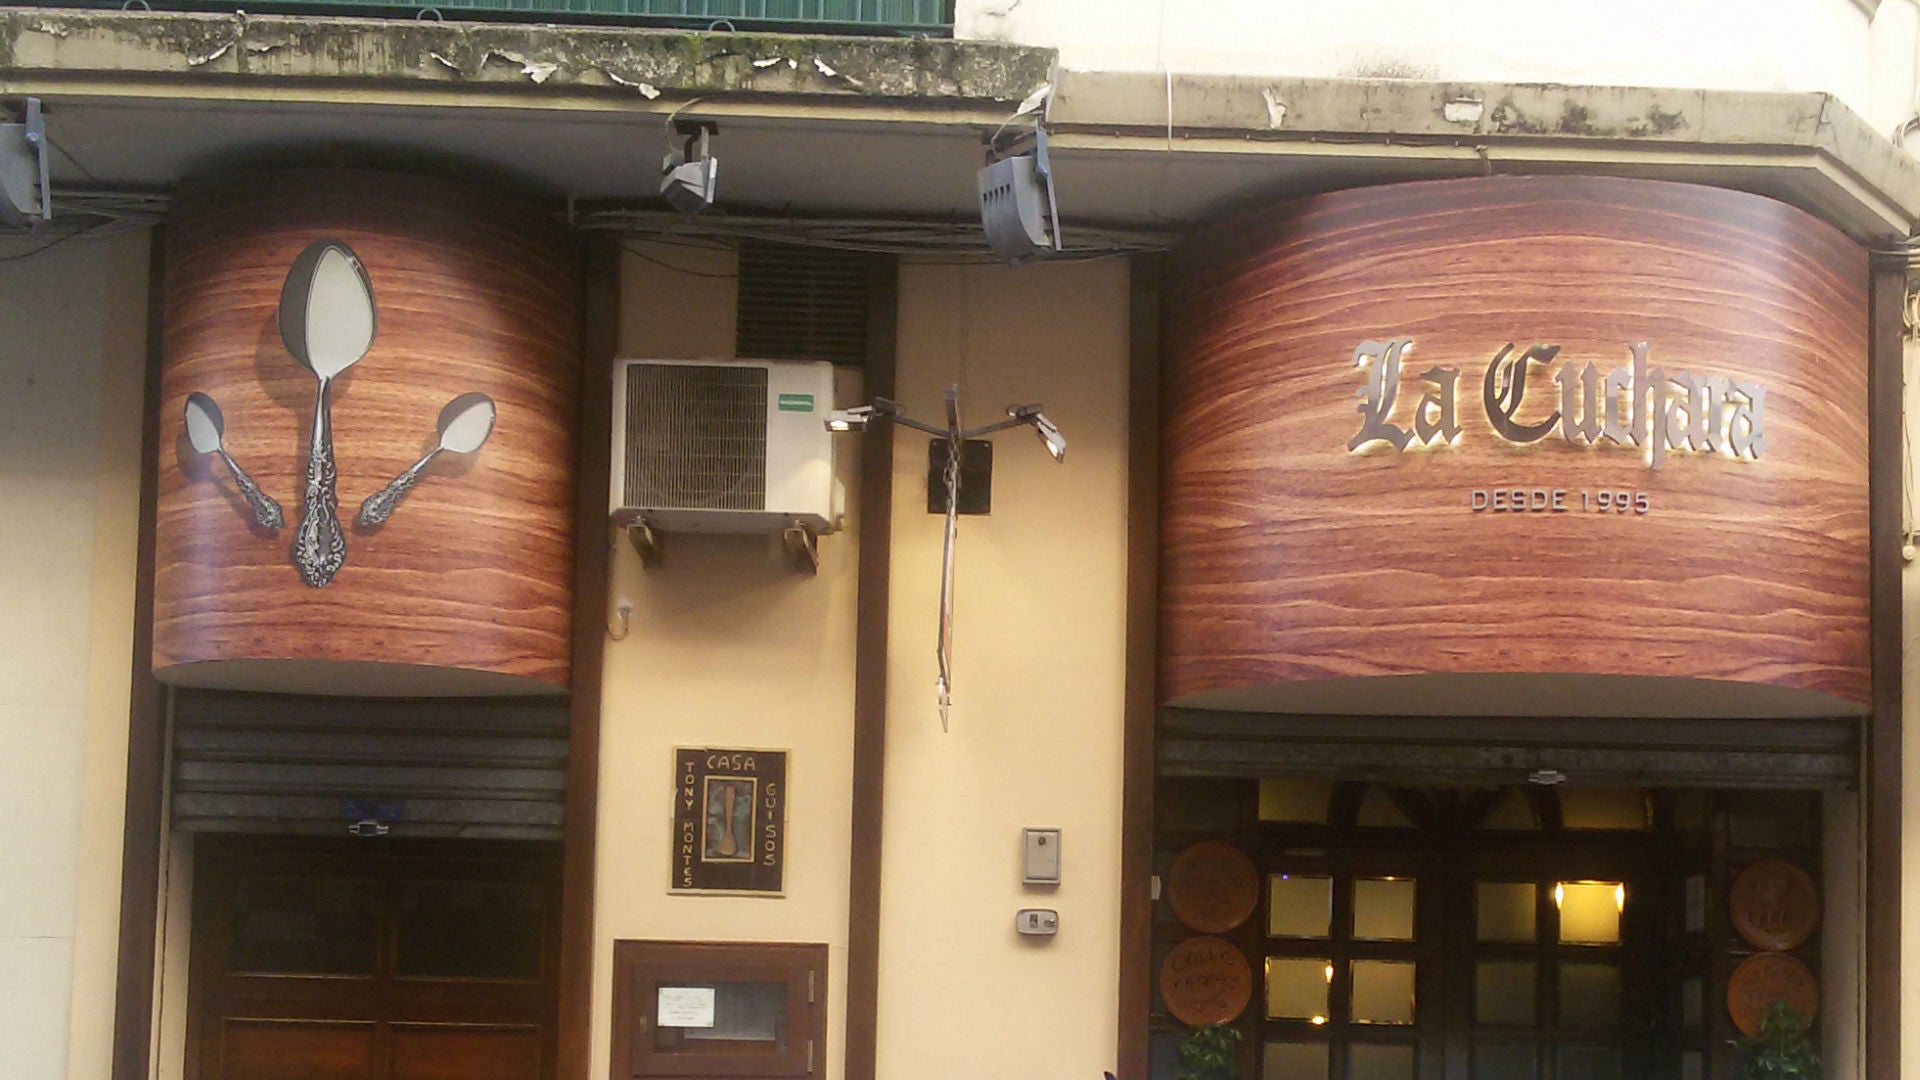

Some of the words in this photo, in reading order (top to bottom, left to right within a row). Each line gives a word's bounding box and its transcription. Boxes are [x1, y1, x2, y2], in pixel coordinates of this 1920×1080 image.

[1346, 335, 1464, 453] La
[1483, 340, 1768, 470] Cuchara
[1470, 488, 1567, 512] DESDE
[1581, 490, 1650, 515] 1995
[684, 761, 695, 811] TONY
[706, 754, 757, 771] CASA
[763, 782, 777, 867] GUISOS
[682, 822, 695, 888] MONTES
